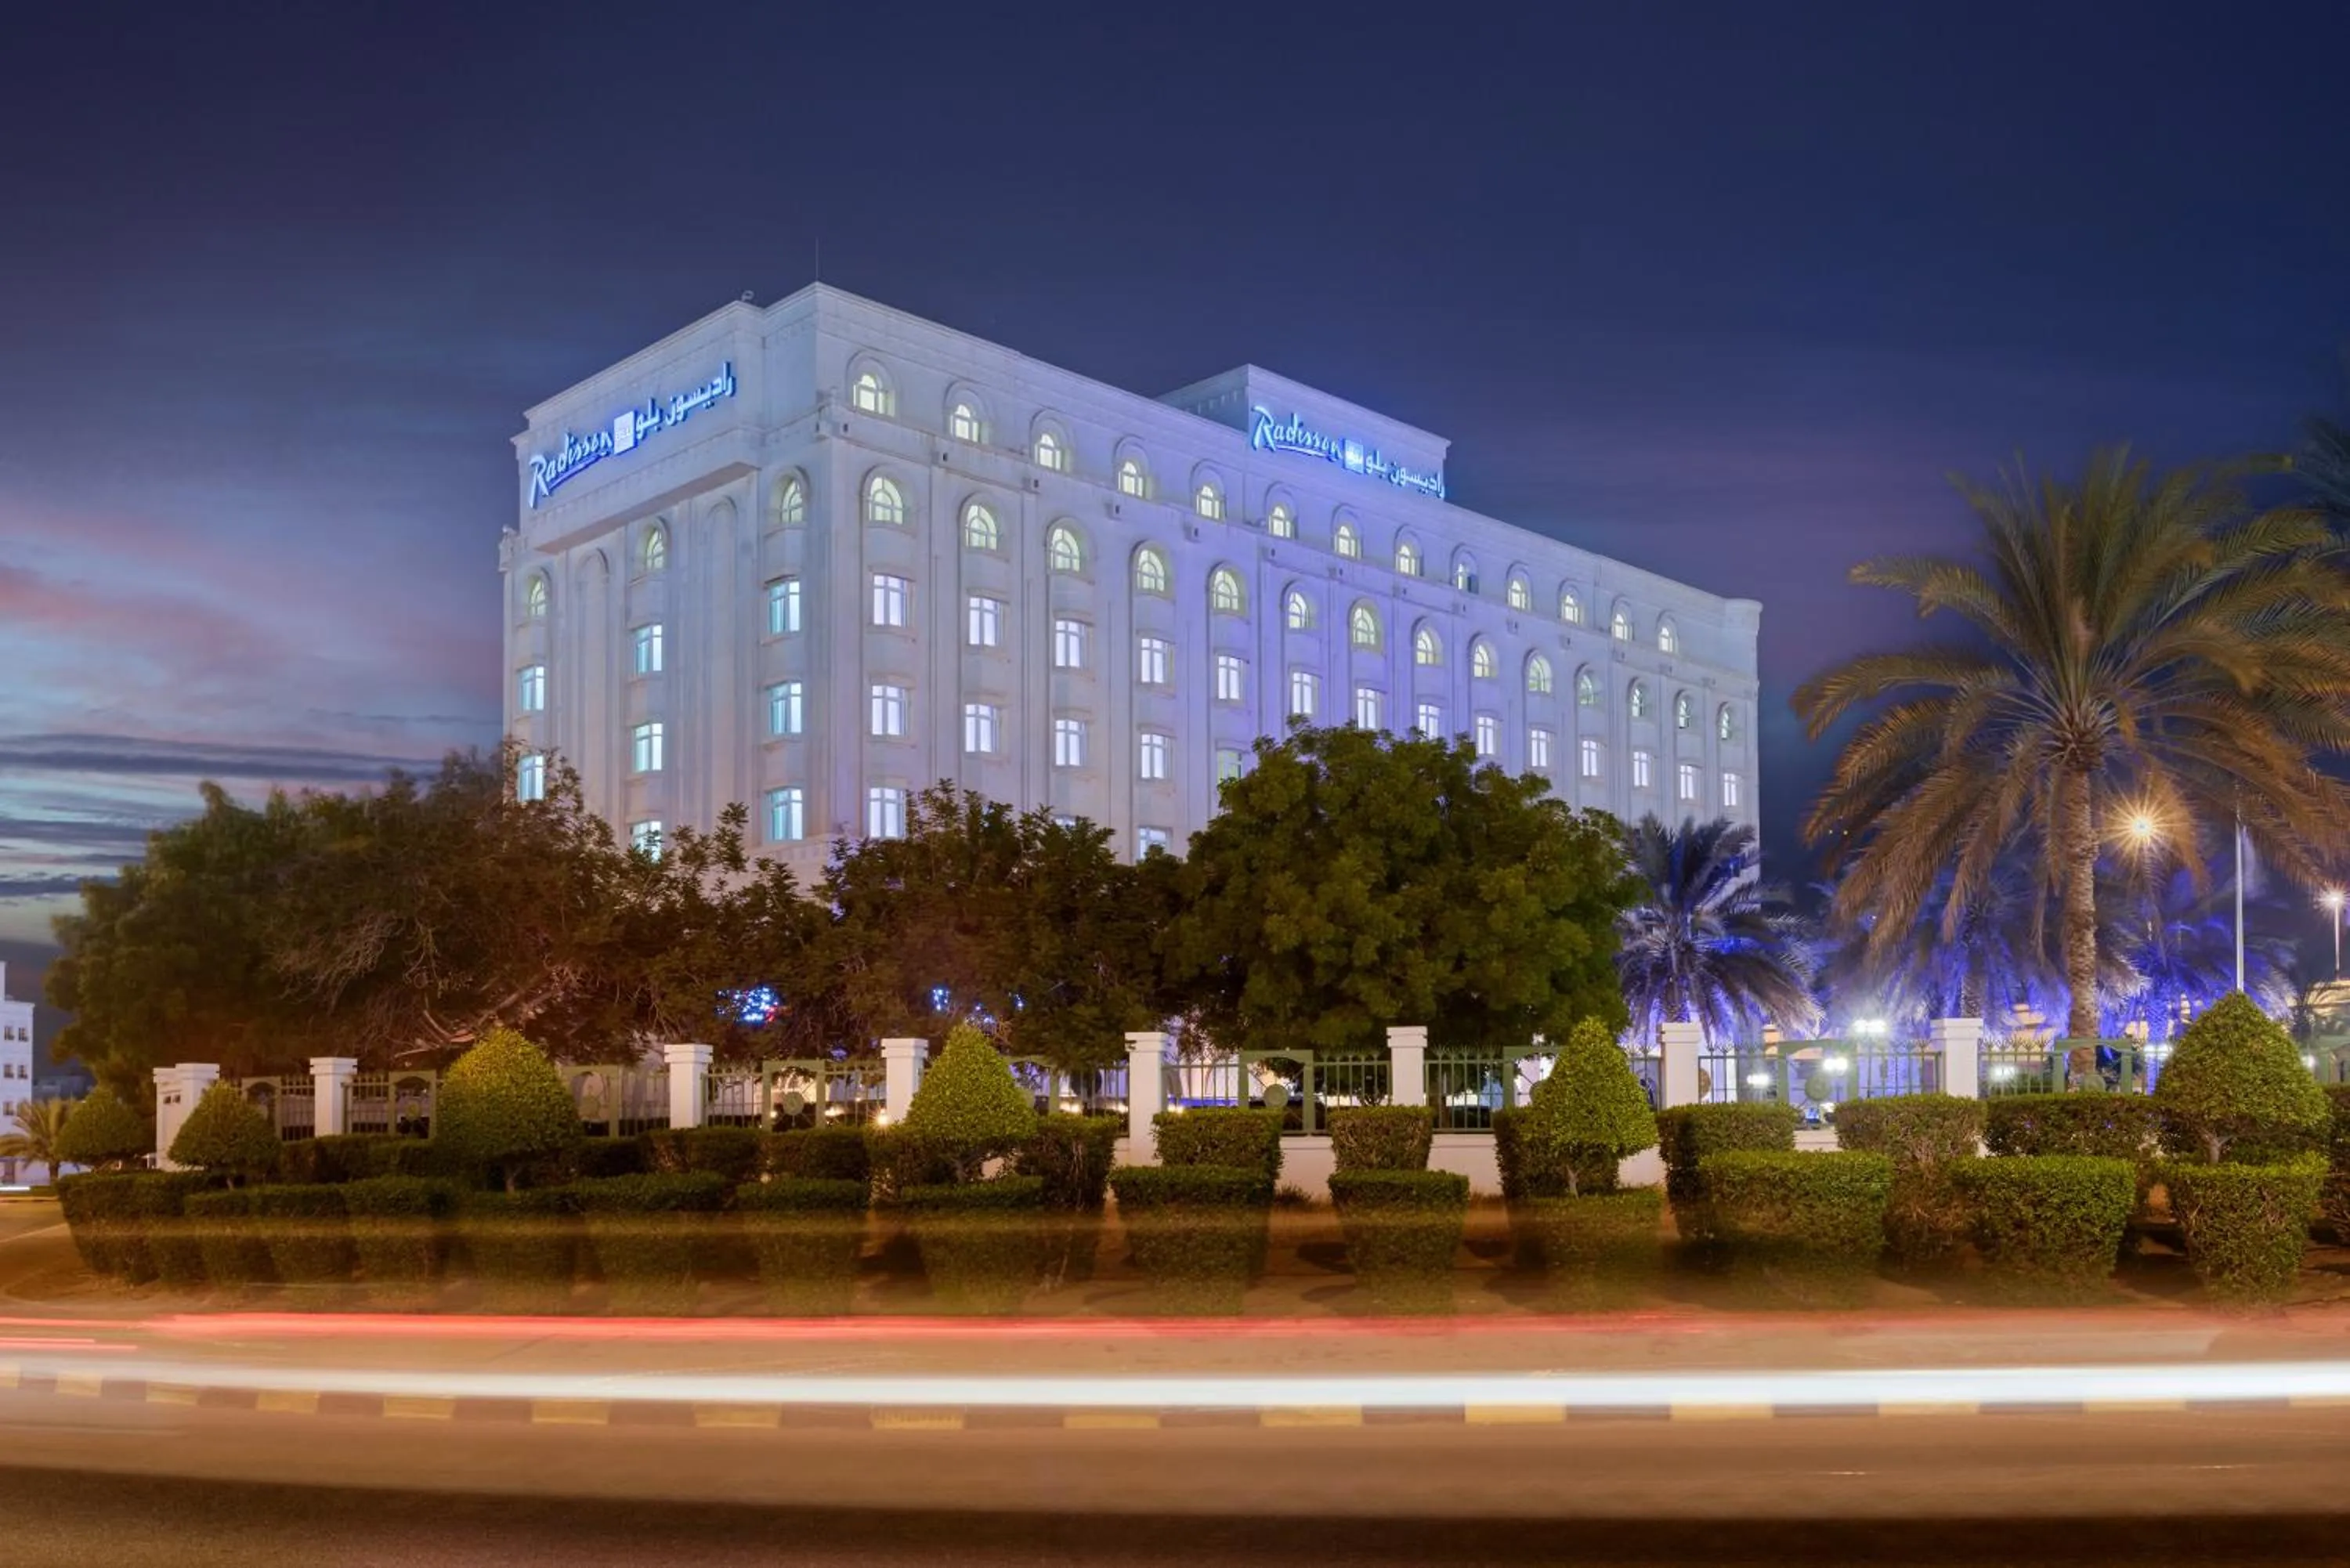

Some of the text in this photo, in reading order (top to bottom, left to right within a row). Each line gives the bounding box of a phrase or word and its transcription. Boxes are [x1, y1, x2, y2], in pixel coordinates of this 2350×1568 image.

[635, 361, 736, 439] راديسون بلو
[1252, 406, 1343, 461] Radisson
[529, 429, 613, 509] Radisson
[1365, 449, 1387, 479] بلو
[1389, 461, 1445, 499] راديسون
